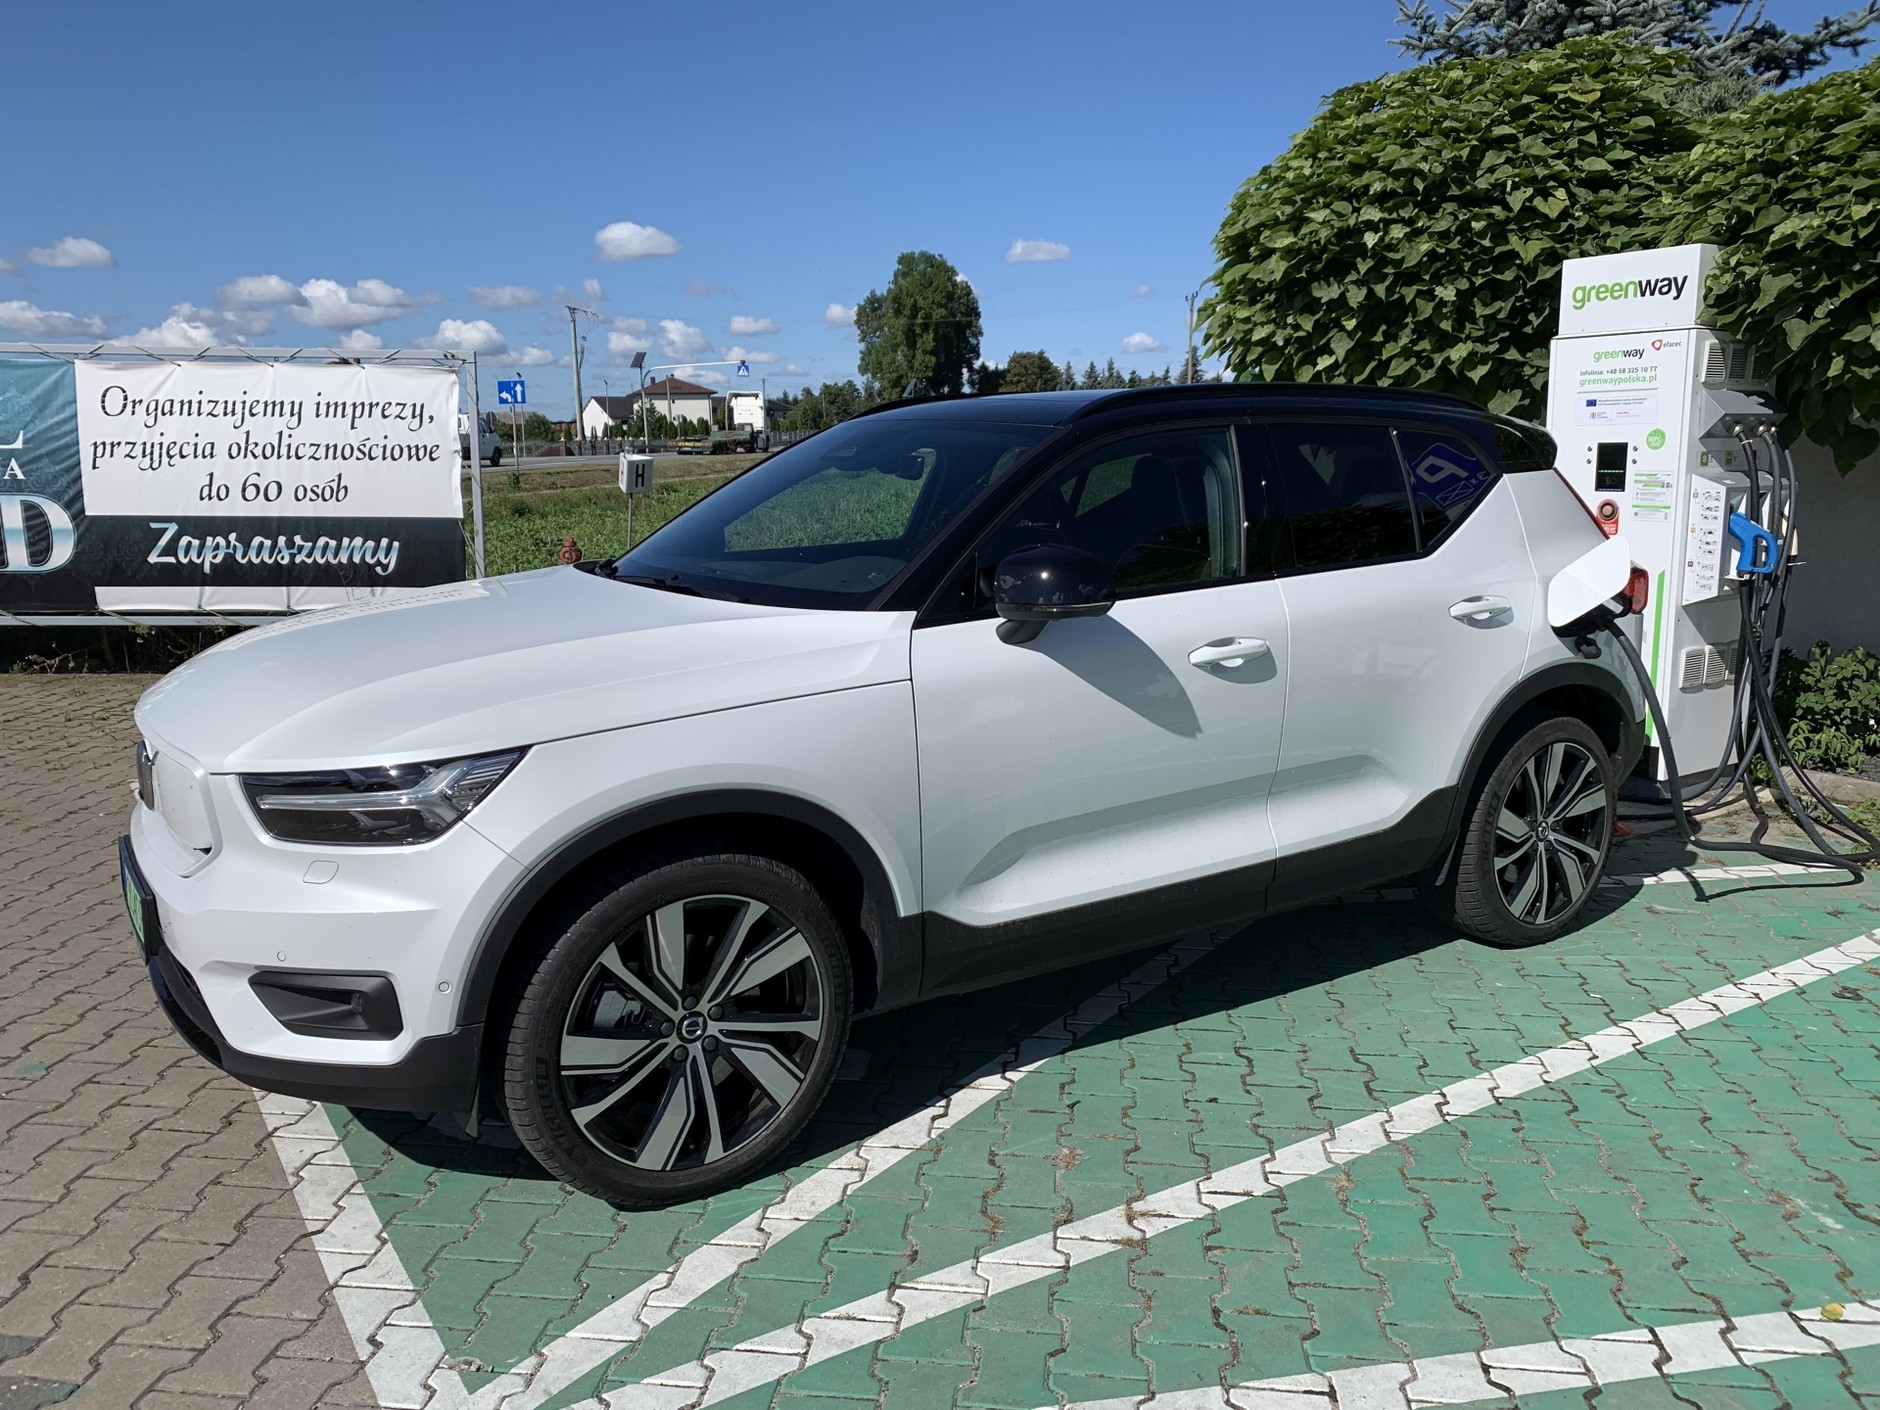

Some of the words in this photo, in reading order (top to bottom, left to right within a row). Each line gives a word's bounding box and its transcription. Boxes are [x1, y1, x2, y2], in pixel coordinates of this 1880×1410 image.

[1572, 275, 1688, 310] greenway
[1593, 348, 1645, 363] greenway
[1579, 373, 1658, 387] greenwaypolska.pl
[100, 384, 304, 429] Organizujemy
[314, 391, 435, 431] imprezy,
[90, 432, 217, 471] przyjęcia
[227, 428, 441, 463] okolicznościowe
[199, 472, 230, 502] do
[240, 473, 283, 502] 60
[293, 472, 349, 502] osób
[635, 463, 646, 487] H
[147, 521, 400, 576] Zapraszamy
